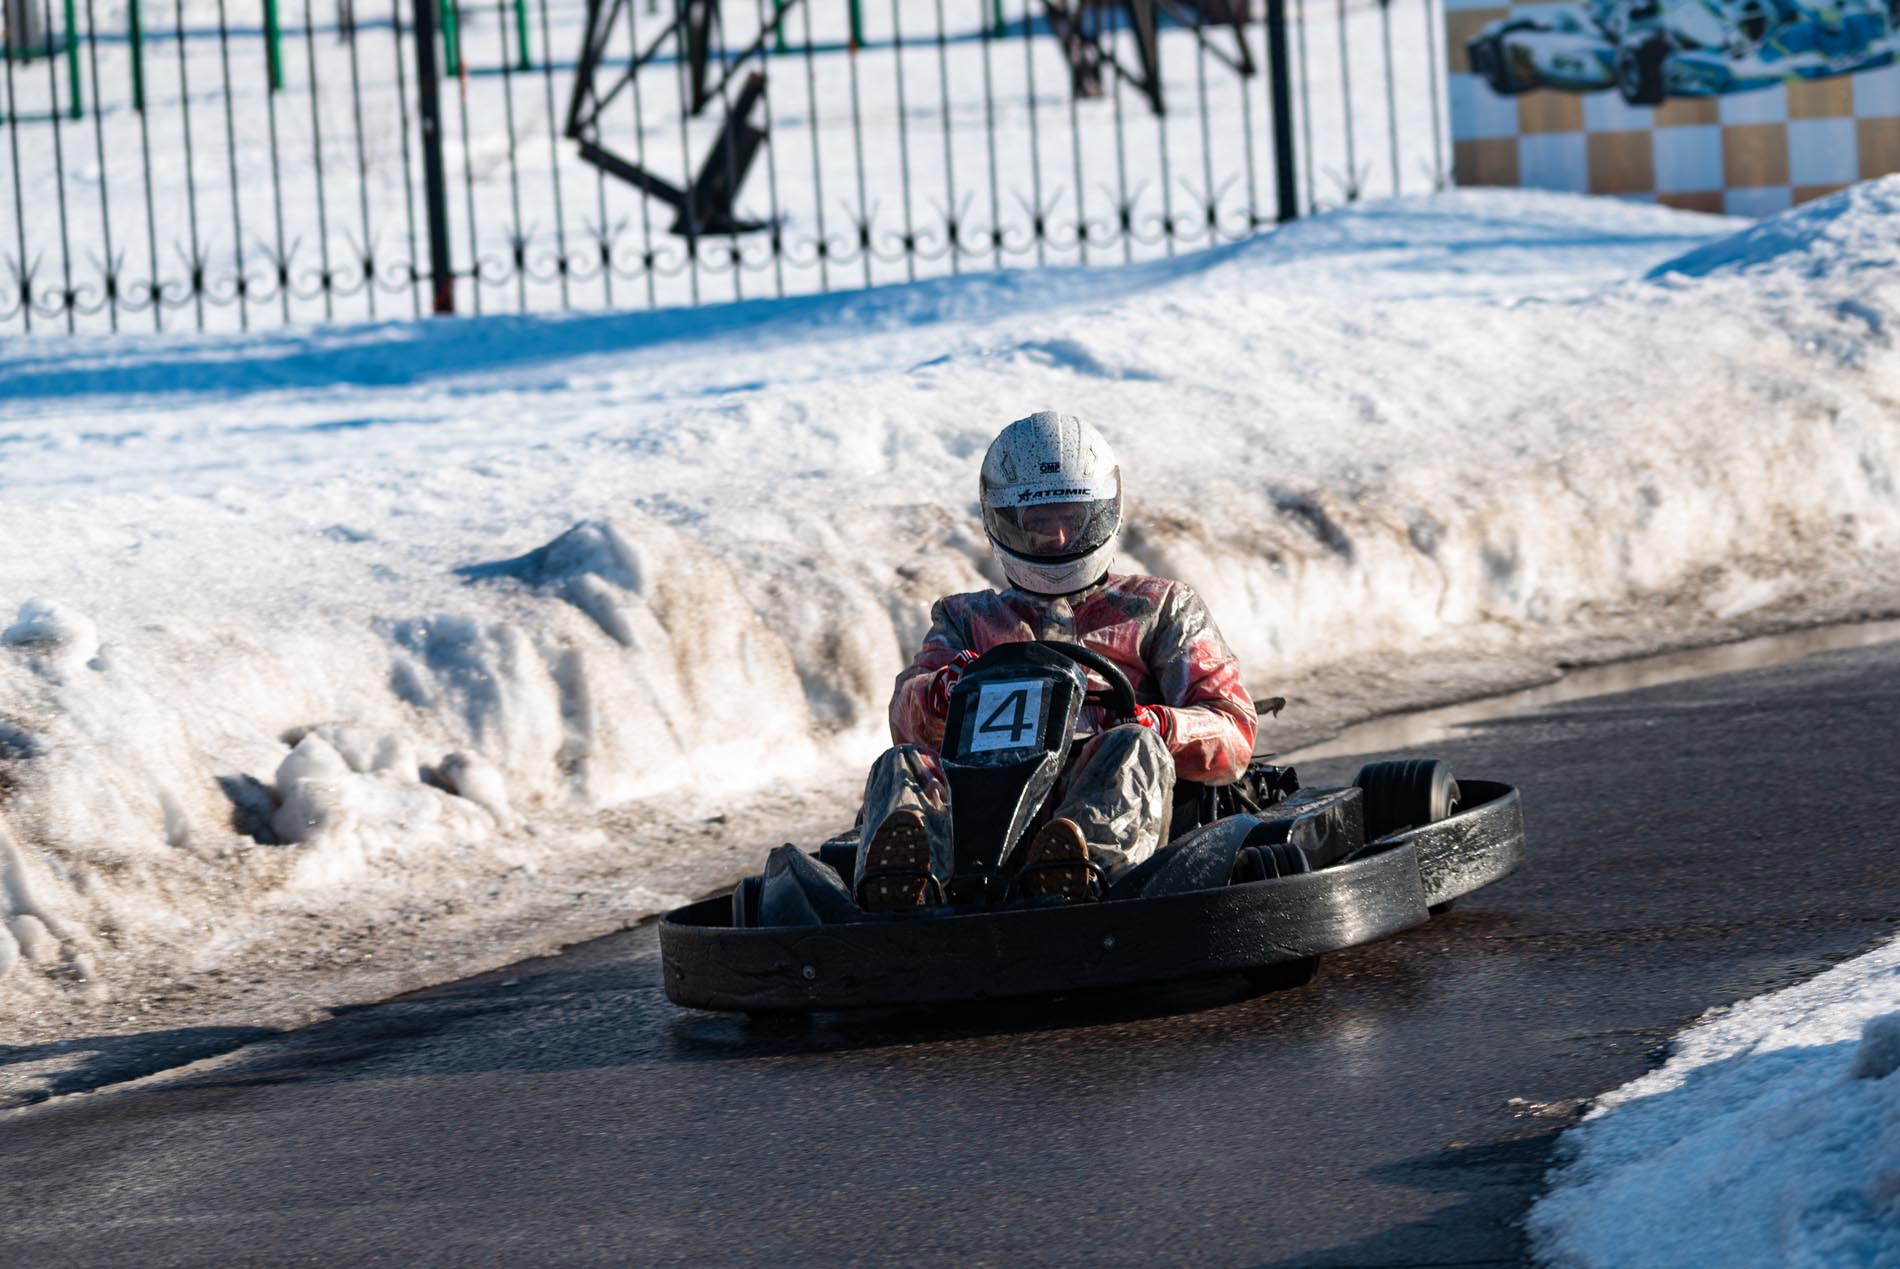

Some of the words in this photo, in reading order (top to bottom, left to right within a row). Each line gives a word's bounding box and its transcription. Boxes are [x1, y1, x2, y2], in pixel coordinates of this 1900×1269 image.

[1039, 462, 1061, 474] OMP
[1032, 488, 1091, 498] ATOMIC
[979, 688, 1034, 742] 4
